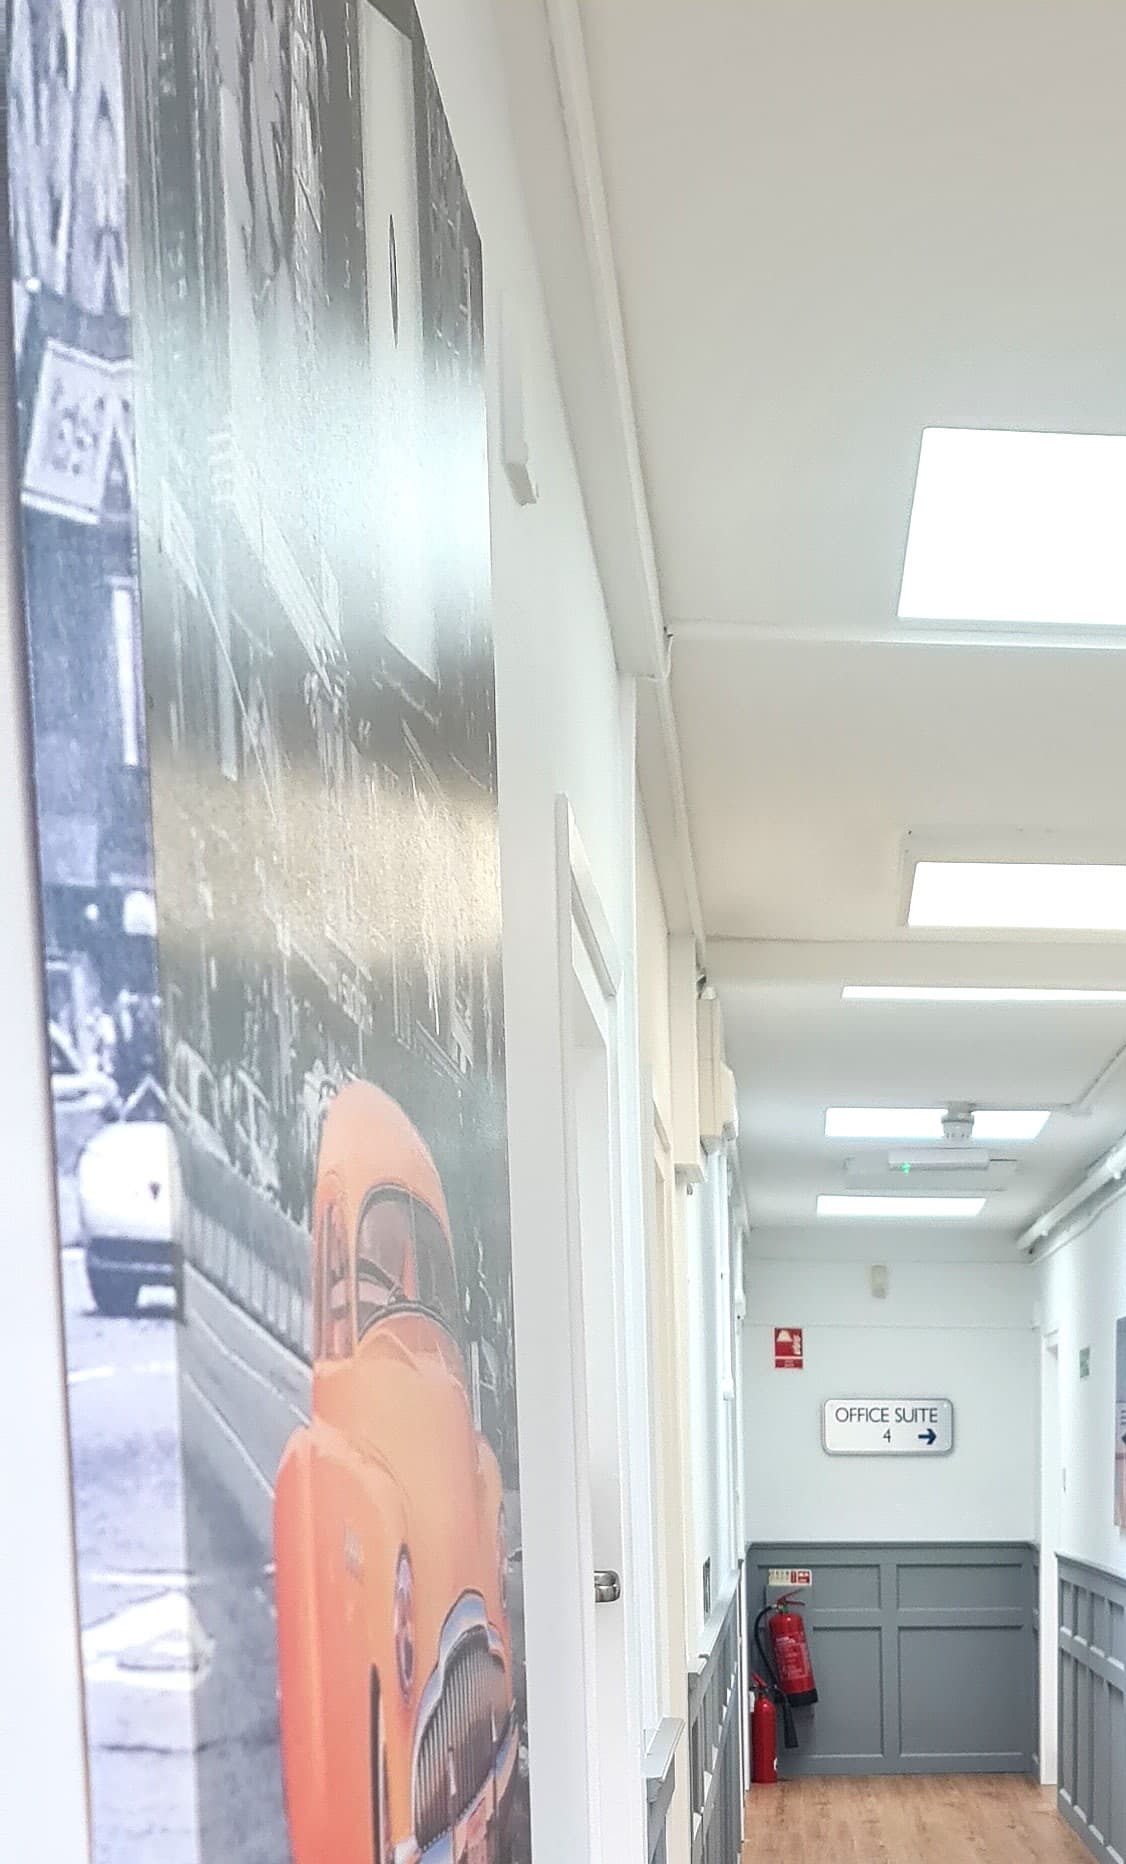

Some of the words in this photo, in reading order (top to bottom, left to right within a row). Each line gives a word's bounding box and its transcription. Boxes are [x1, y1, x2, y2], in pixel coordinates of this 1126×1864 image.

[835, 1407, 890, 1423] OFFICE
[895, 1407, 938, 1423] SUITE
[883, 1428, 891, 1443] 4
